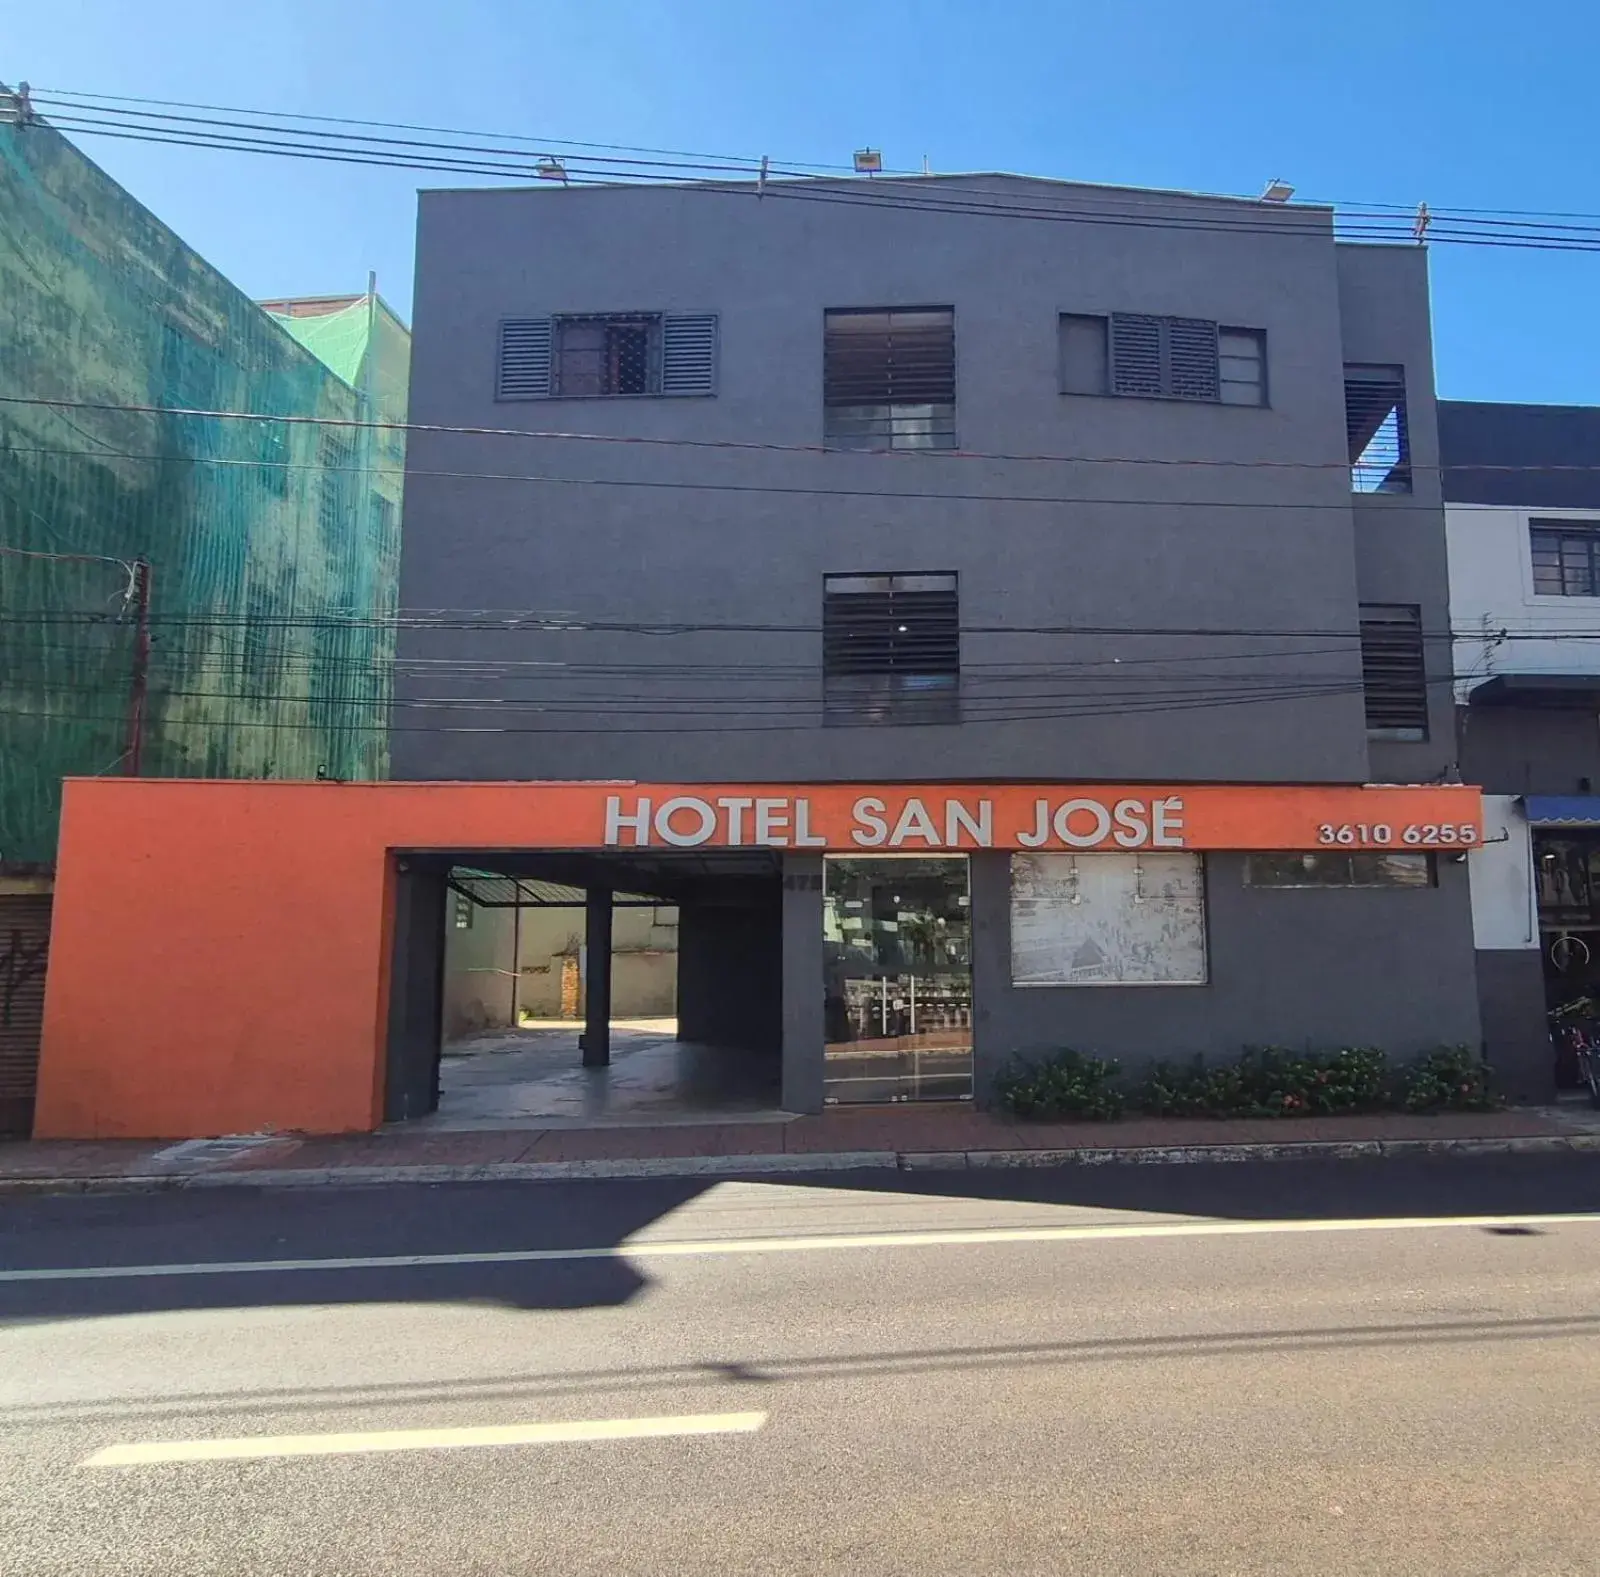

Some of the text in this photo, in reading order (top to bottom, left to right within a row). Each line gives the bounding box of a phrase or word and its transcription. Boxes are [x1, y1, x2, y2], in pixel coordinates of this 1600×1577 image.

[604, 796, 1185, 848] HOTEL SAN JOSÉ
[1319, 823, 1478, 845] 3610 6255
